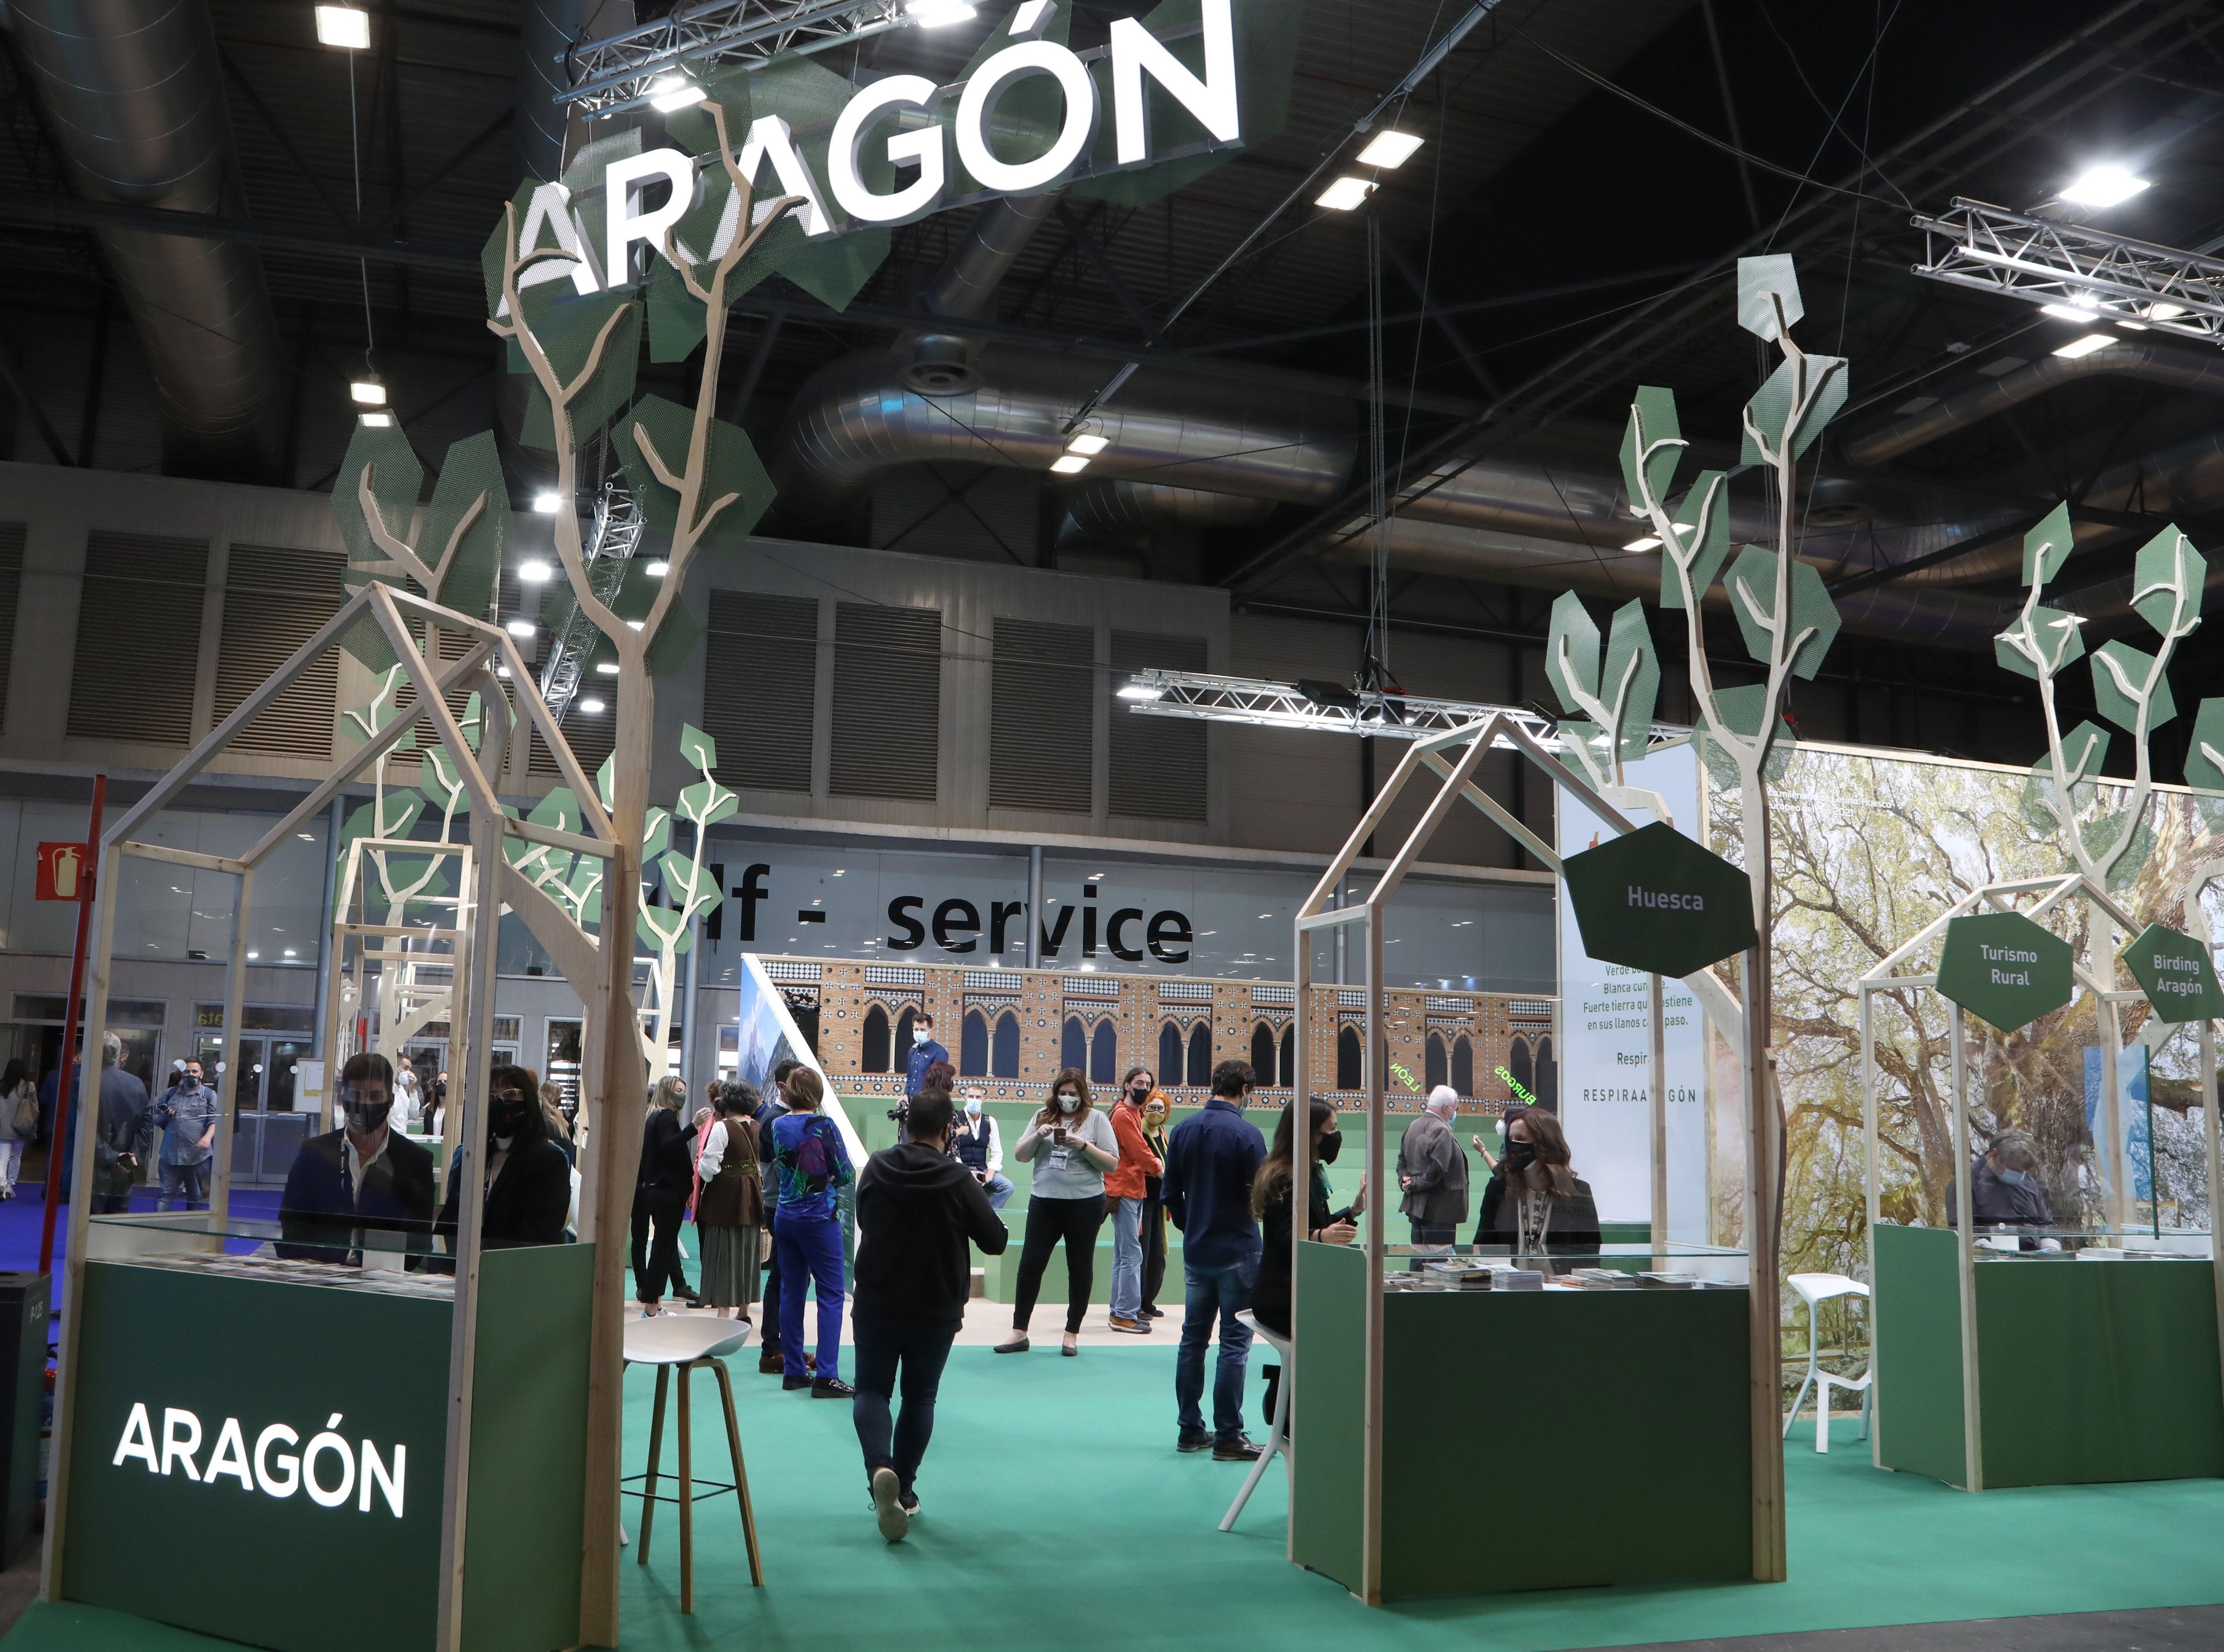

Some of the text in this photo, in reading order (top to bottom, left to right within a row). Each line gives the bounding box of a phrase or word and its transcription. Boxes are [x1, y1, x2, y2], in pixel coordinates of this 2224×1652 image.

[496, 0, 1242, 318] ARAGÓN
[1833, 807, 1854, 817] 2021
[1628, 885, 1704, 911] Huesca
[887, 885, 1193, 963] service
[1980, 944, 2037, 963] Turismo
[1606, 965, 1629, 976] Verde
[2153, 954, 2200, 975] Birding
[1991, 969, 2030, 986] Rural
[1603, 983, 1631, 995] Blanca
[2157, 978, 2202, 997] Aragón
[1583, 1002, 1610, 1013] Fuerte
[1612, 999, 1635, 1011] tierra
[1588, 1021, 1597, 1030] en
[1599, 1020, 1613, 1029] sus
[1615, 1017, 1640, 1029] llanos
[1664, 1016, 1688, 1029] paso.
[1617, 1052, 1649, 1068] Respir
[112, 1402, 406, 1518] ARAGÓN
